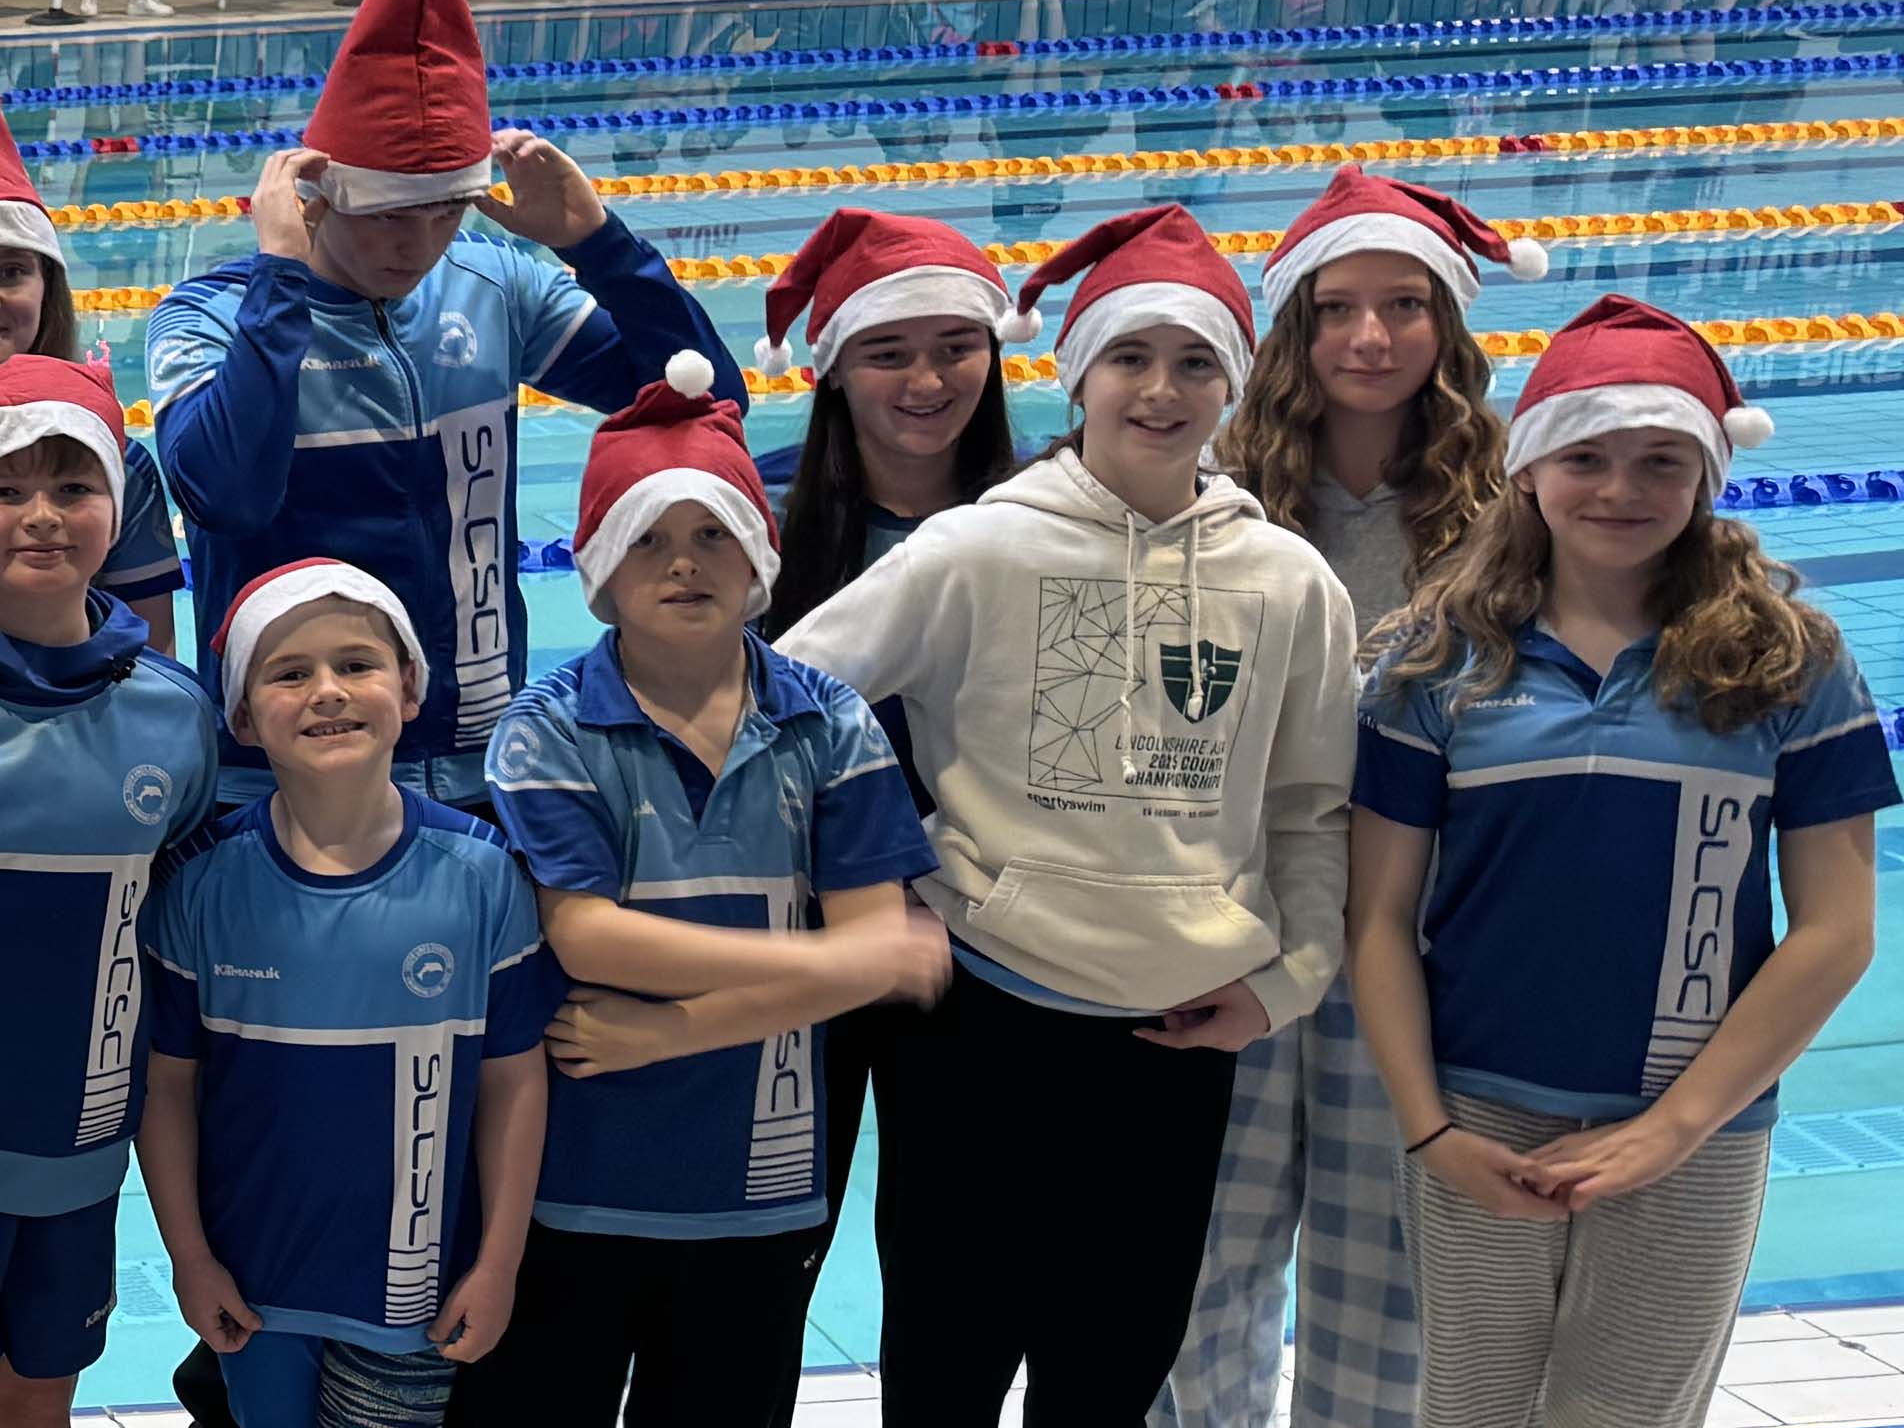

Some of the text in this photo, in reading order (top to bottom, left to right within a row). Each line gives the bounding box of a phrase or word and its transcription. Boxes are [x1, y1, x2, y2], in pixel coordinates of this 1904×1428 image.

[461, 425, 501, 655] SLCSC
[98, 879, 138, 1070] SLCSC
[1677, 793, 1740, 1016] SLCSC
[408, 1052, 441, 1246] SLCSC
